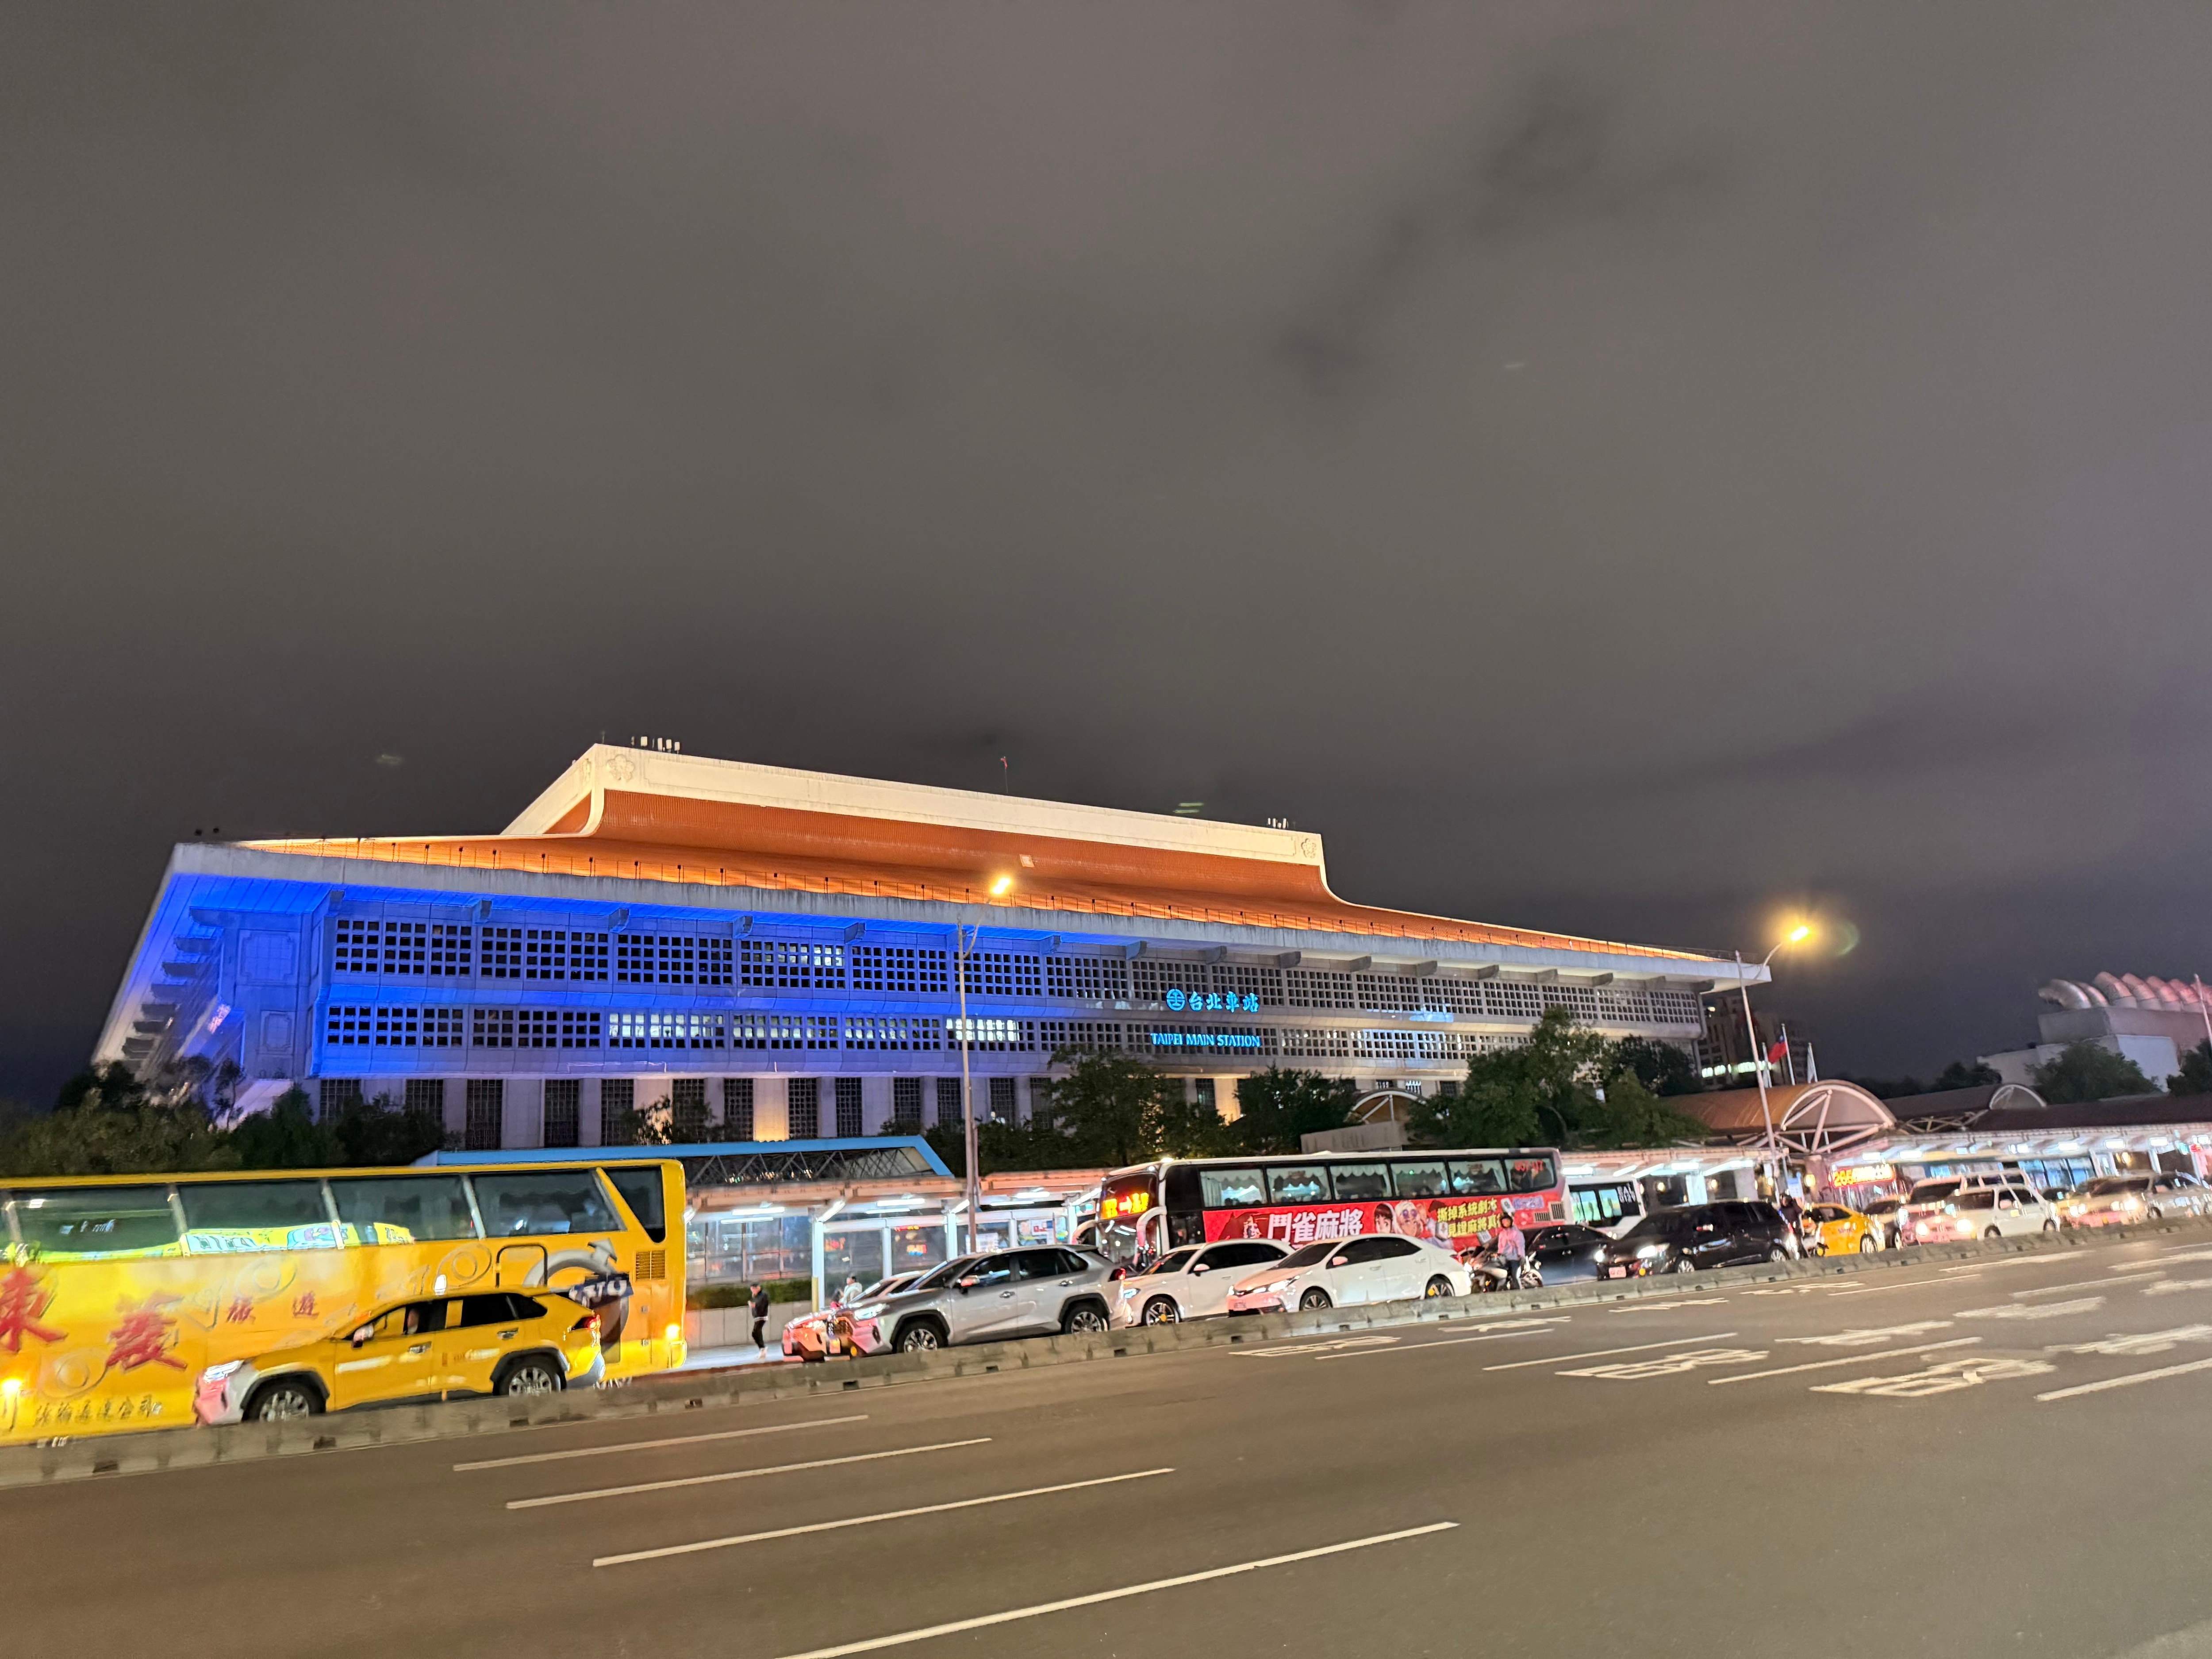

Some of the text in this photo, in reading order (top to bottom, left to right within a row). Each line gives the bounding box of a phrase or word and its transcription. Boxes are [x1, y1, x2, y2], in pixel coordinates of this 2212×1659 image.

[1189, 991, 1260, 1013] 台北車站
[1150, 1033, 1260, 1047] TAIPEI MAIN STATION
